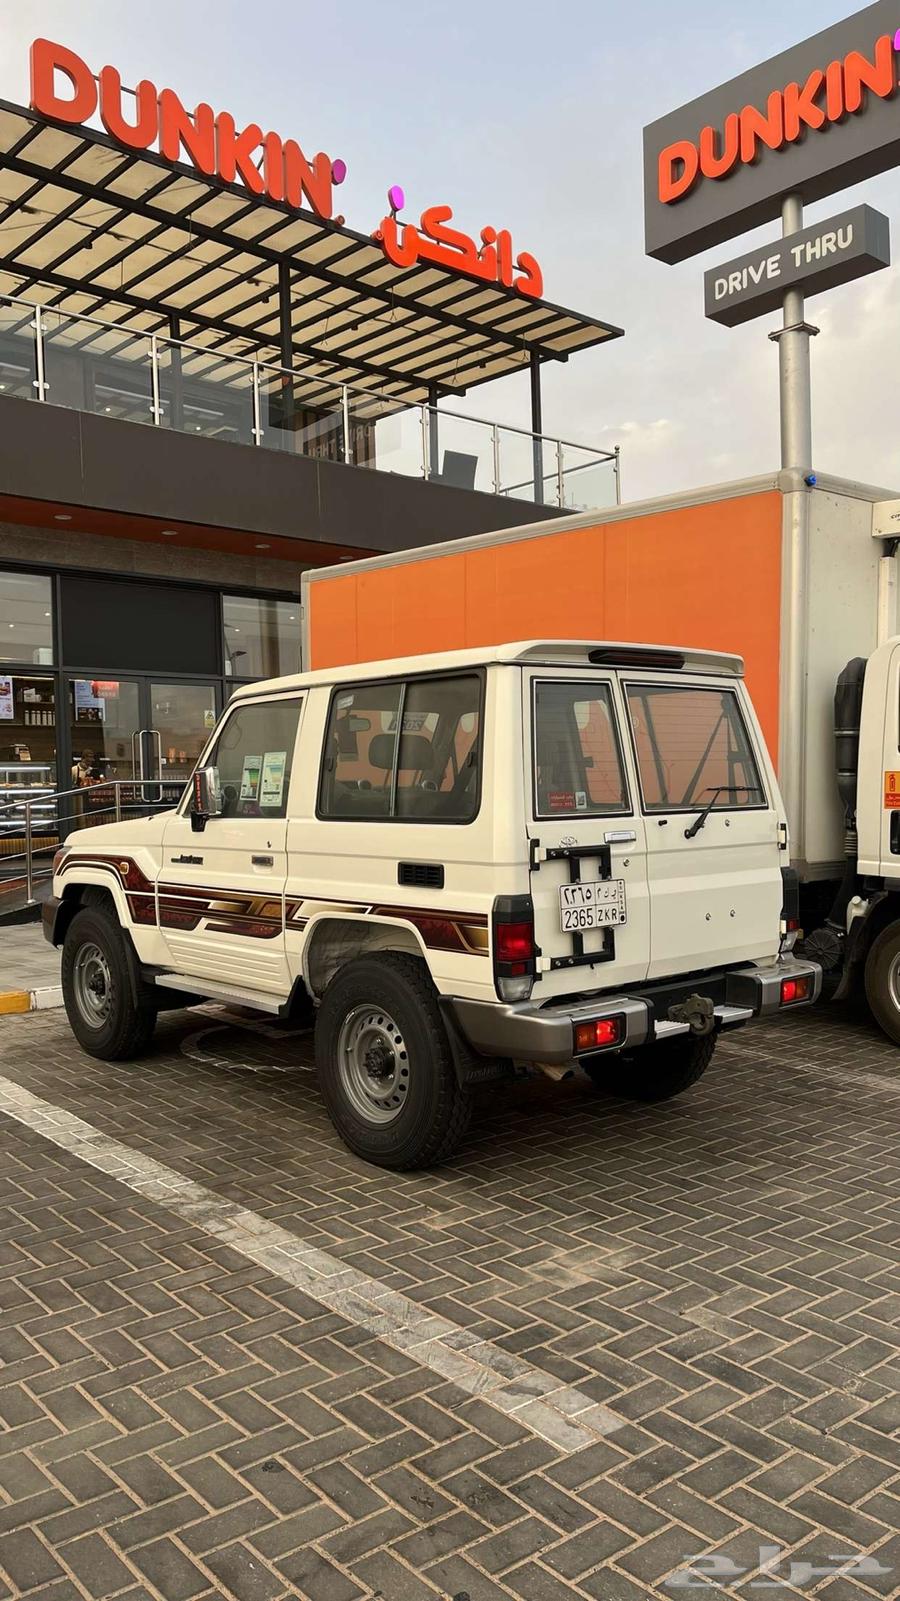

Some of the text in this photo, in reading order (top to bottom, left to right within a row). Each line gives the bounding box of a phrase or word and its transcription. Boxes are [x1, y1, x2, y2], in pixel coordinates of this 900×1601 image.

[30, 38, 346, 220] DUNKIN'
[380, 185, 543, 298] دانكن
[714, 224, 853, 300] DRIVE THRU
[565, 907, 617, 929] 2365 ZKR
